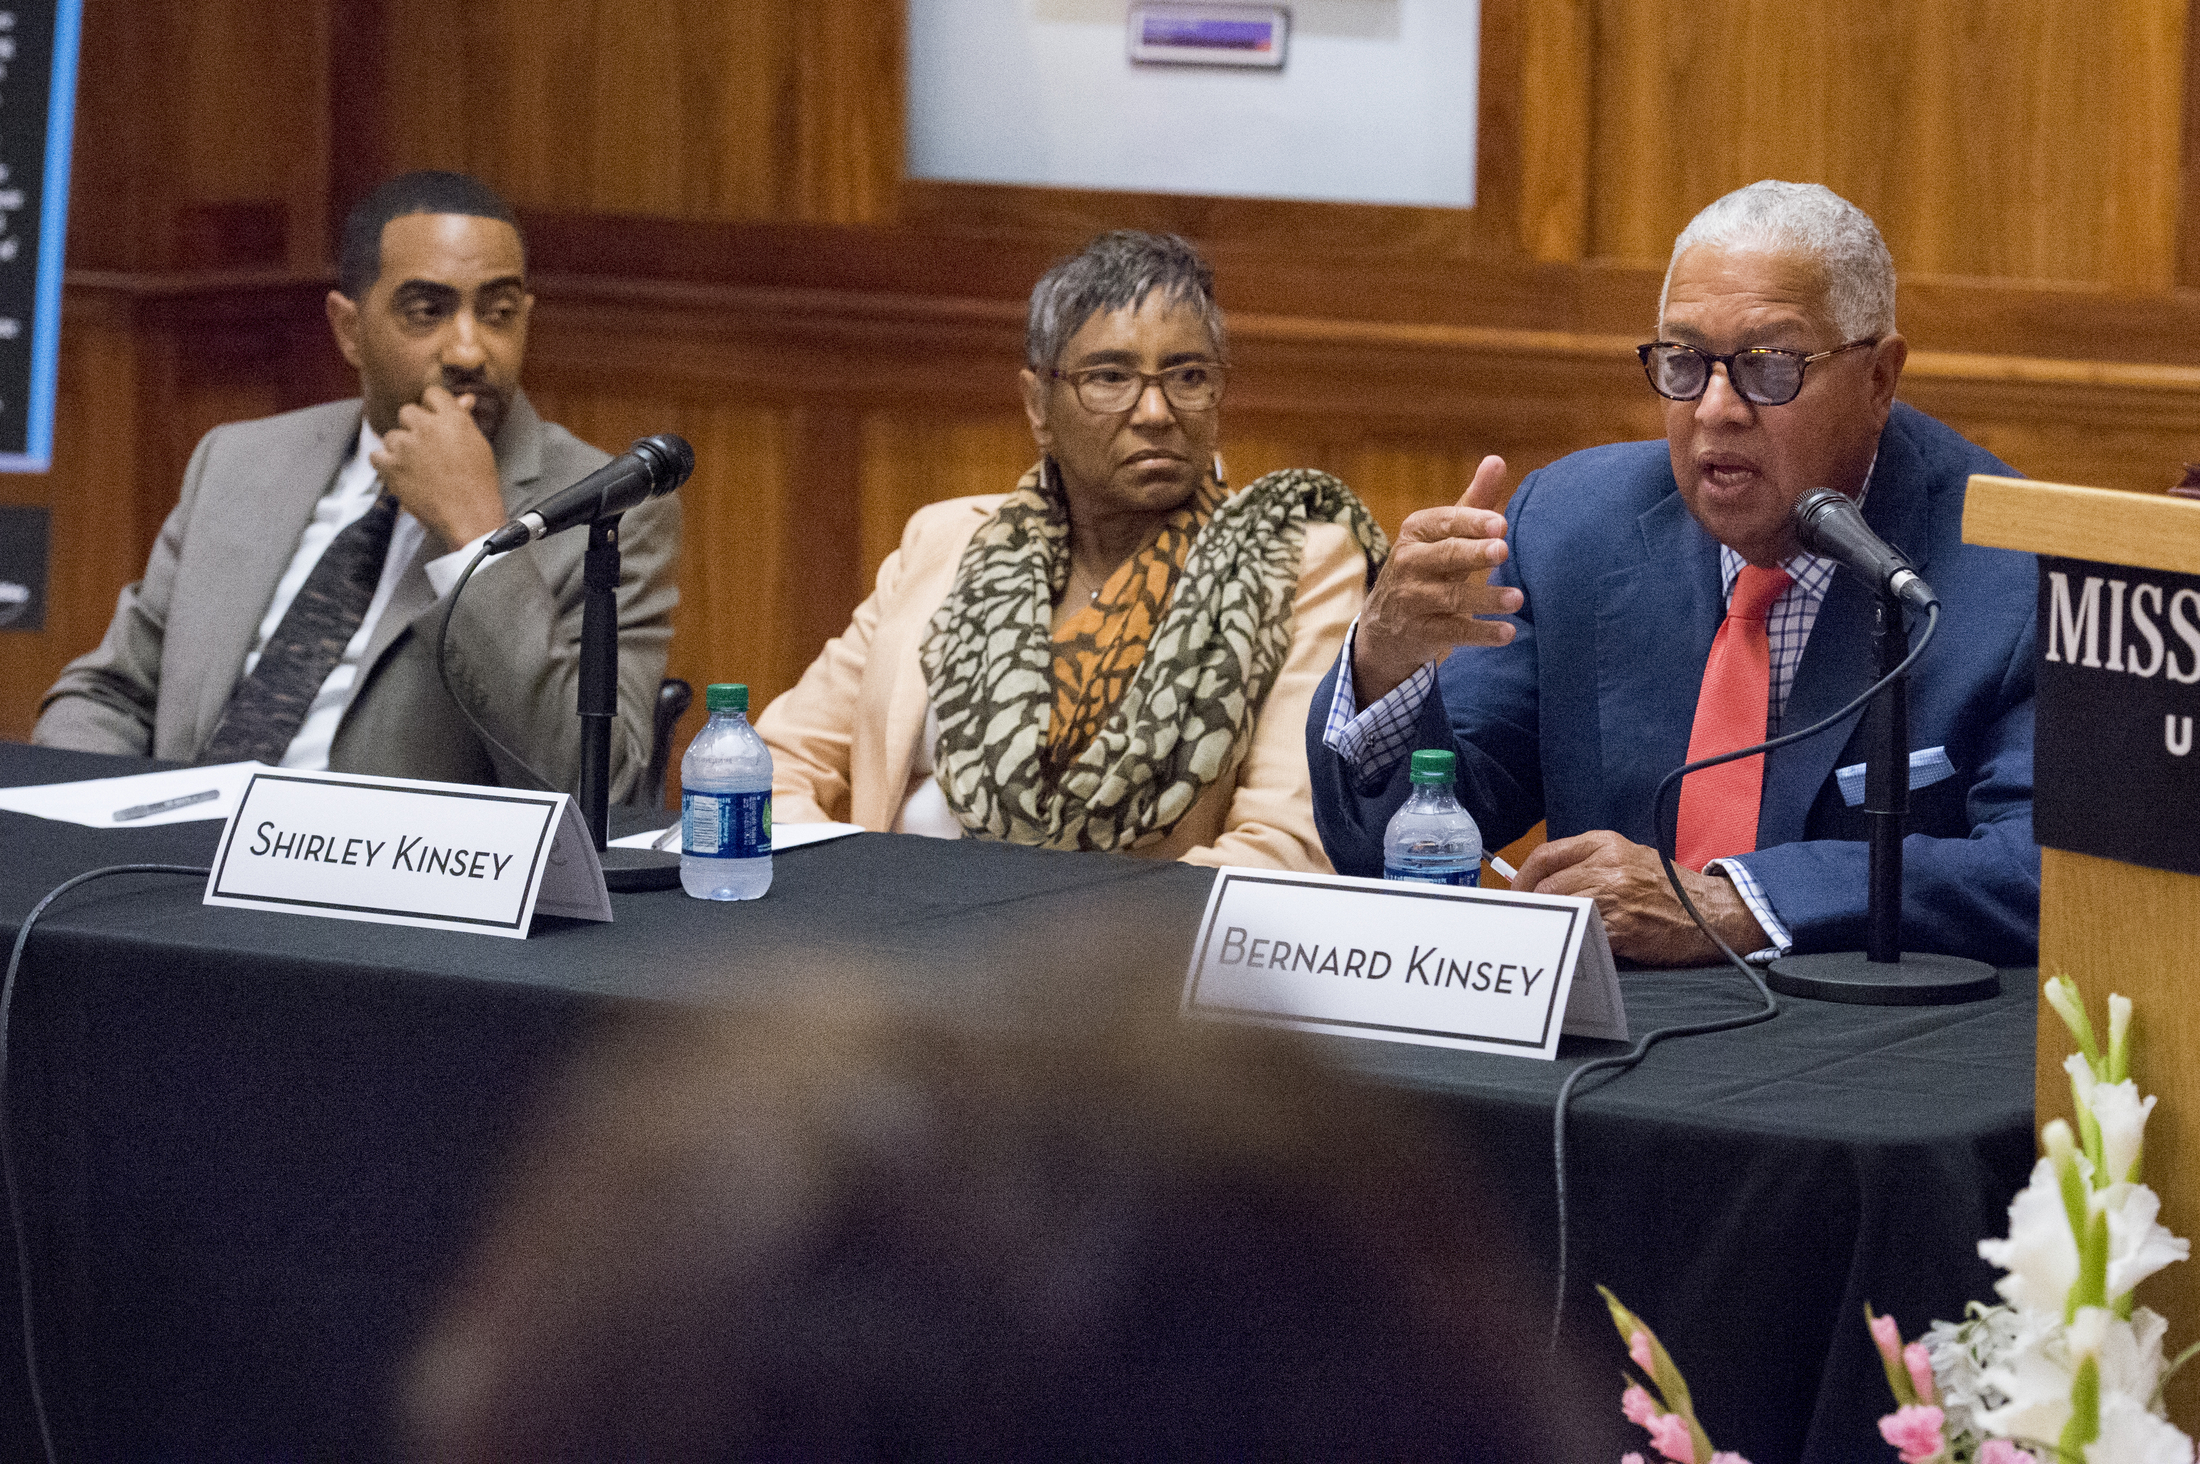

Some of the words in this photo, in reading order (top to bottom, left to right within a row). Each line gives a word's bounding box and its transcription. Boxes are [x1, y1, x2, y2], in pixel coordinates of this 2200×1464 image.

[2045, 571, 2200, 685] MISS
[249, 821, 386, 867] SHIRLEY
[391, 835, 514, 881] KINSEY
[1218, 926, 1393, 980] BERNARD
[1404, 945, 1545, 997] KINSEY
